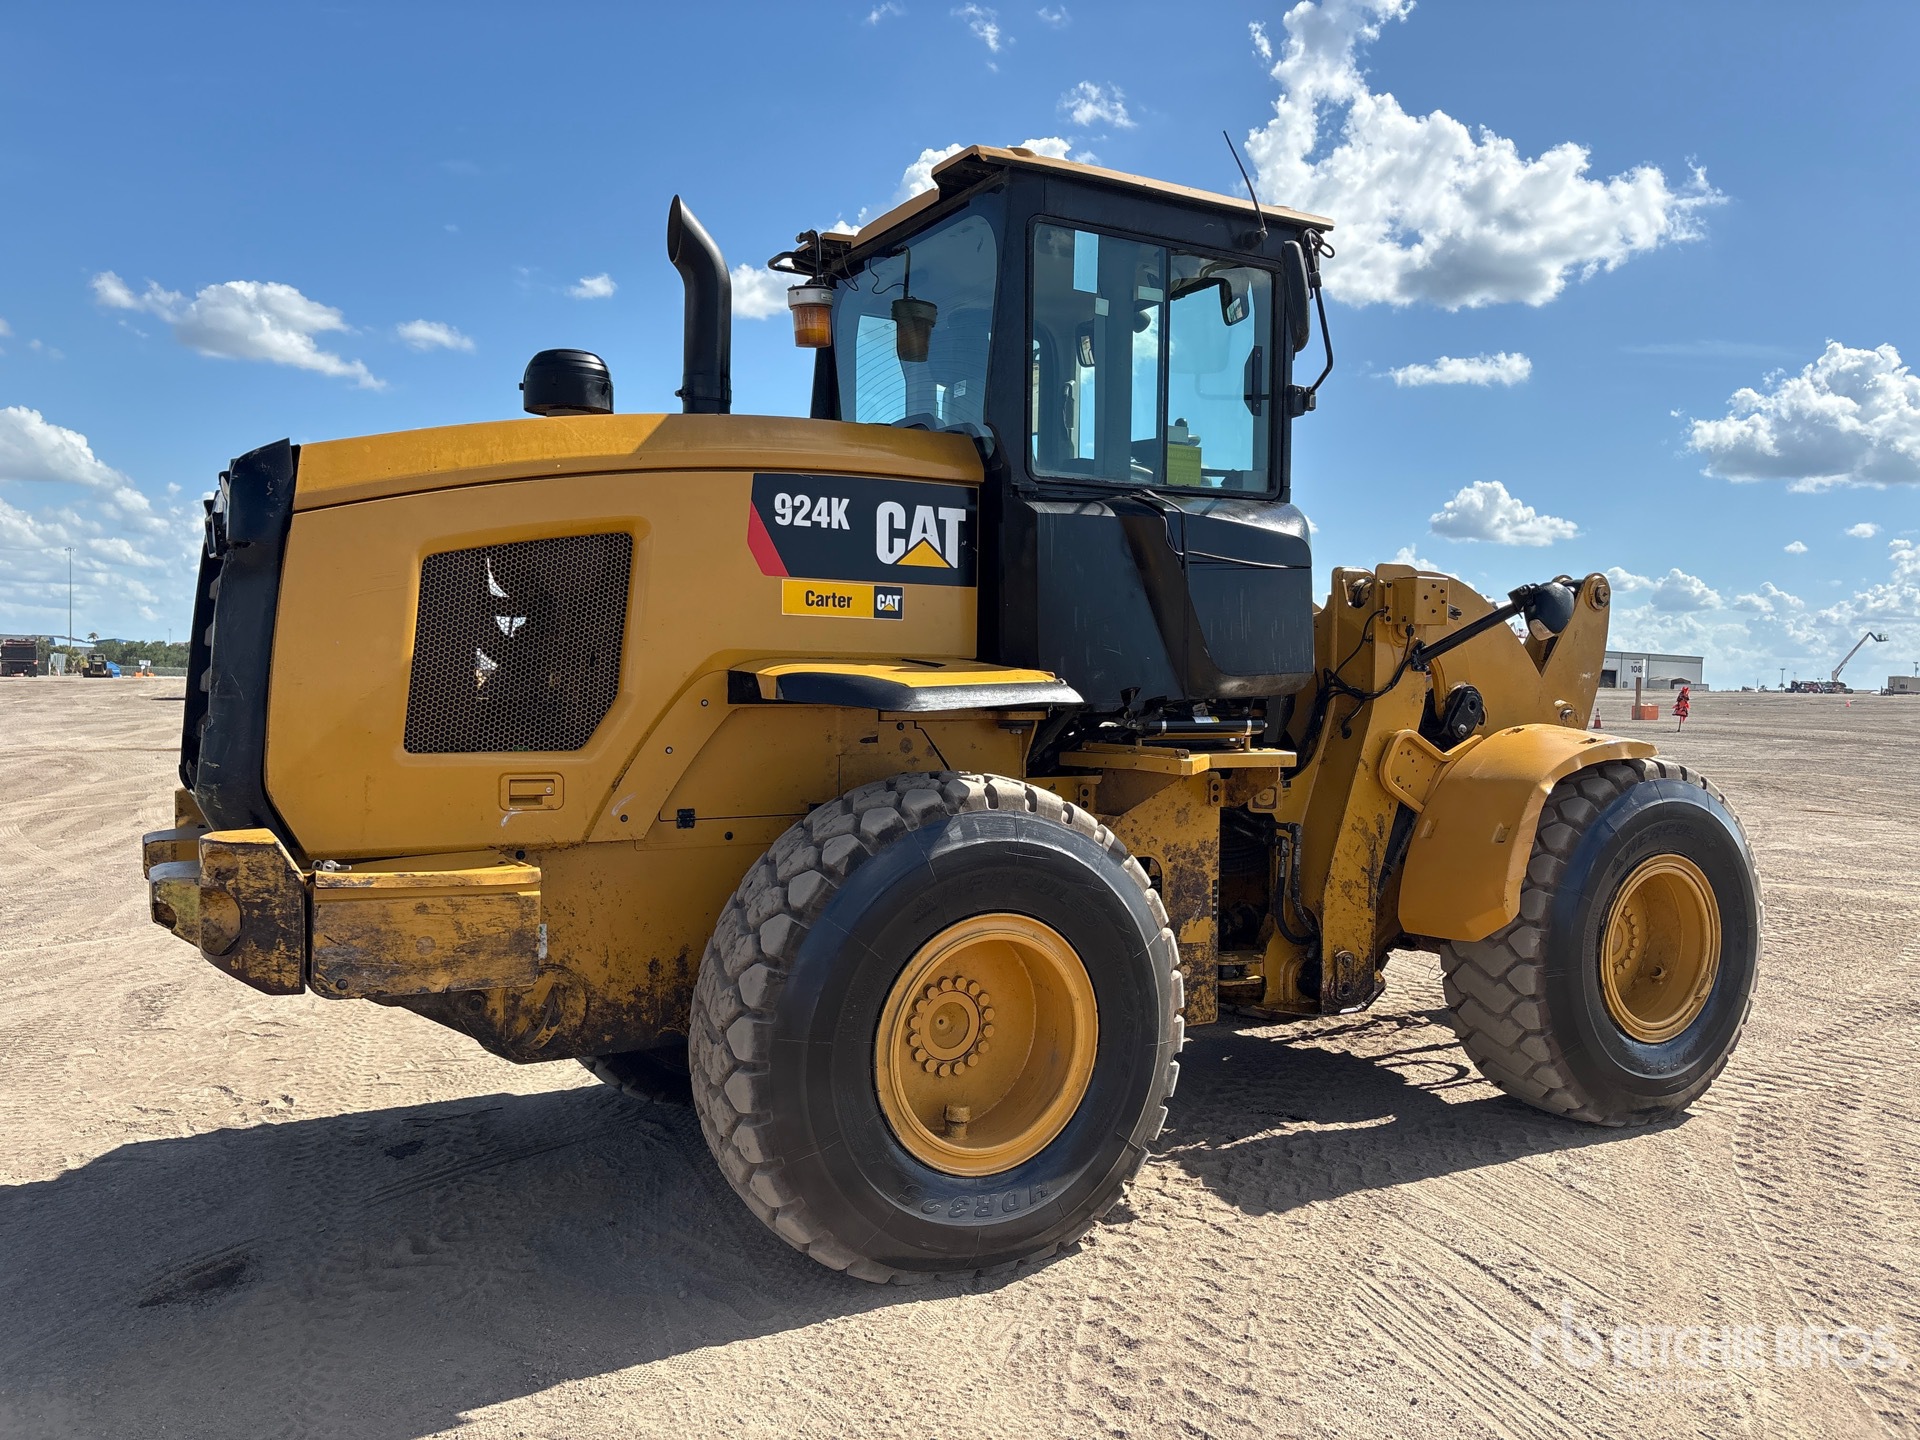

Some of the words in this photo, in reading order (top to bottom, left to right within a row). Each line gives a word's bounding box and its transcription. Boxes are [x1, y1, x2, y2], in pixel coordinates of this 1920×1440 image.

[773, 492, 851, 531] 924K
[876, 501, 967, 569] CAT
[805, 590, 853, 609] Carter
[876, 593, 902, 612] CAT
[1630, 665, 1643, 673] 108
